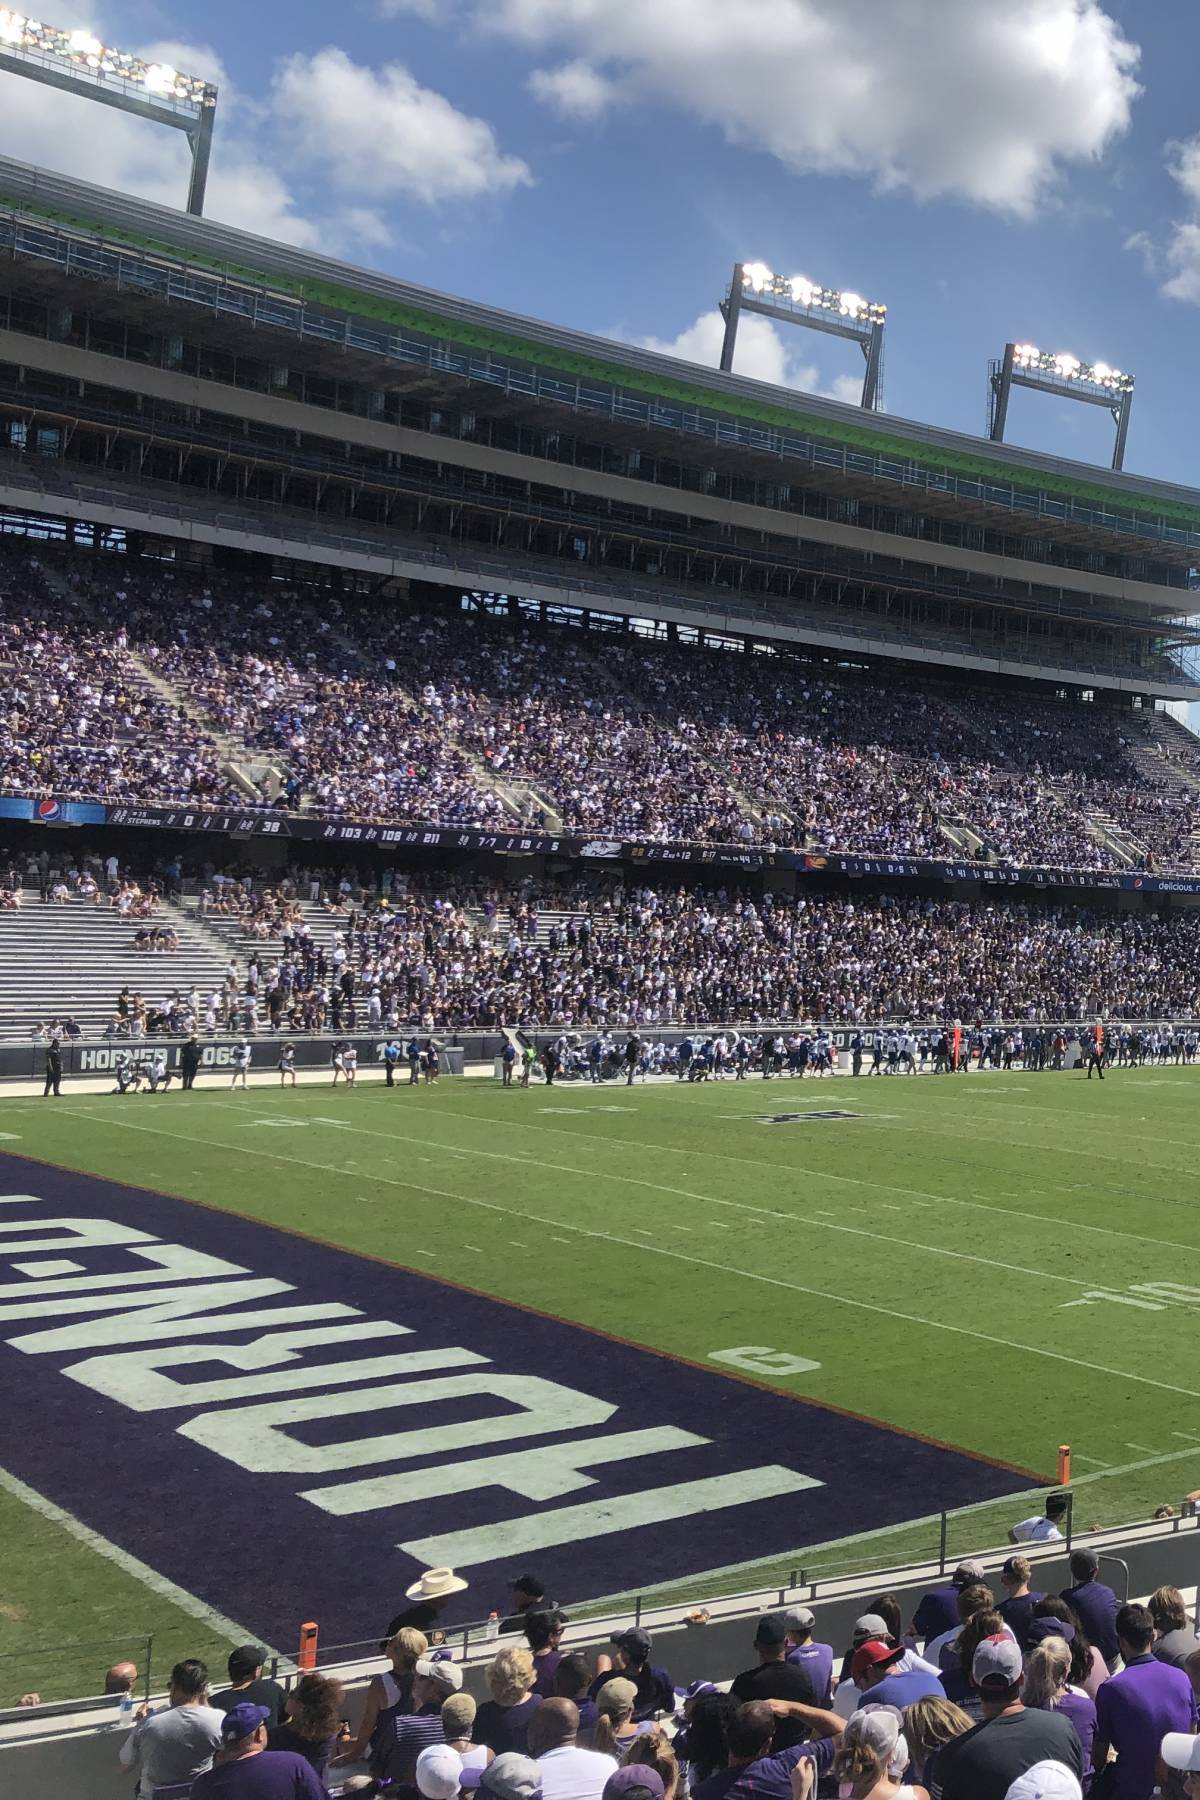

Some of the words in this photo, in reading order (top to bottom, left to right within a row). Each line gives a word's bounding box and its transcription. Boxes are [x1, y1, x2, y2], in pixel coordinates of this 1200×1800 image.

[262, 821, 280, 833] 38
[340, 828, 361, 839] 103
[423, 833, 440, 844] 211
[1158, 882, 1194, 893] delicious.
[707, 1345, 823, 1376] G
